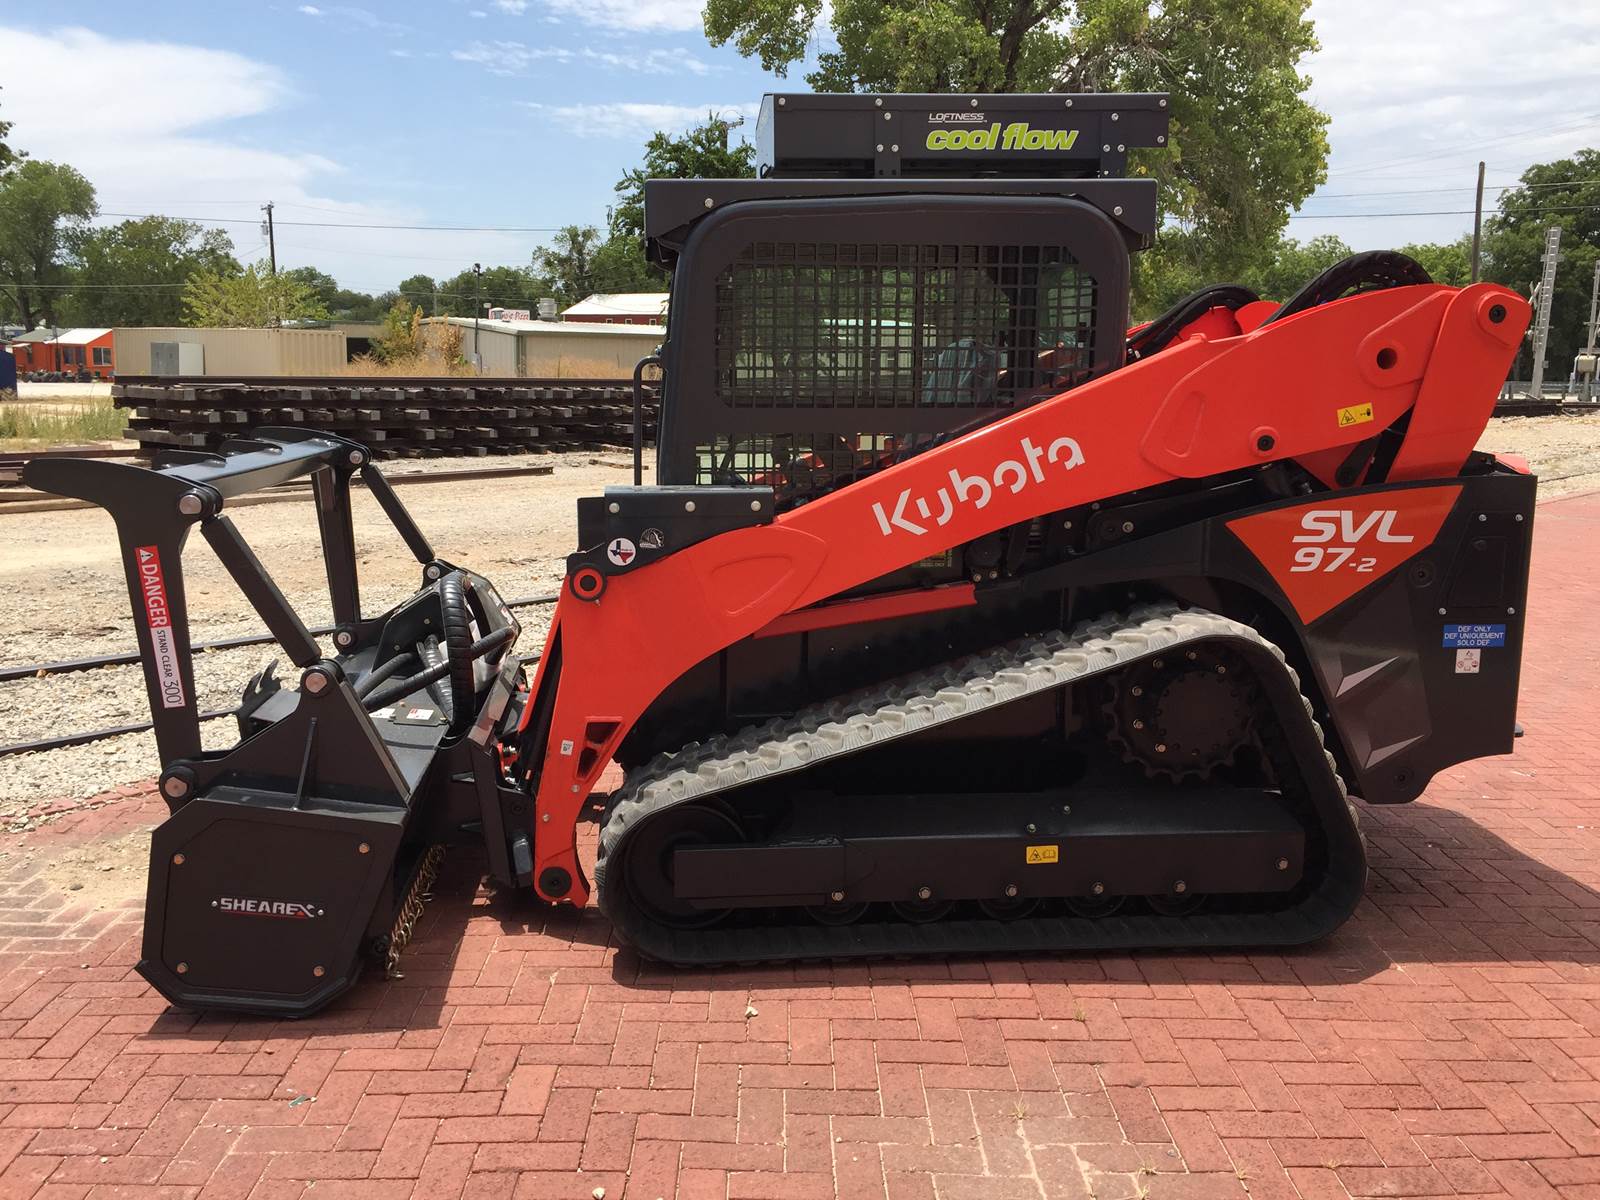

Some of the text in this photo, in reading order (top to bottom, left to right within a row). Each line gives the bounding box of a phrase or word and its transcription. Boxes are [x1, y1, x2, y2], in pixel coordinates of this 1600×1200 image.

[928, 112, 985, 122] LOFTNESS
[926, 123, 1079, 150] cool flow
[871, 436, 1086, 536] Kubota
[1292, 510, 1415, 543] SVL
[1290, 546, 1377, 572] 97-2
[141, 563, 168, 627] DANGER
[156, 629, 168, 654] STAND
[162, 655, 173, 678] CLEAR
[1457, 625, 1491, 633] DEF ONLY
[1444, 632, 1458, 640] DEF
[220, 897, 315, 918] SHEAREX
